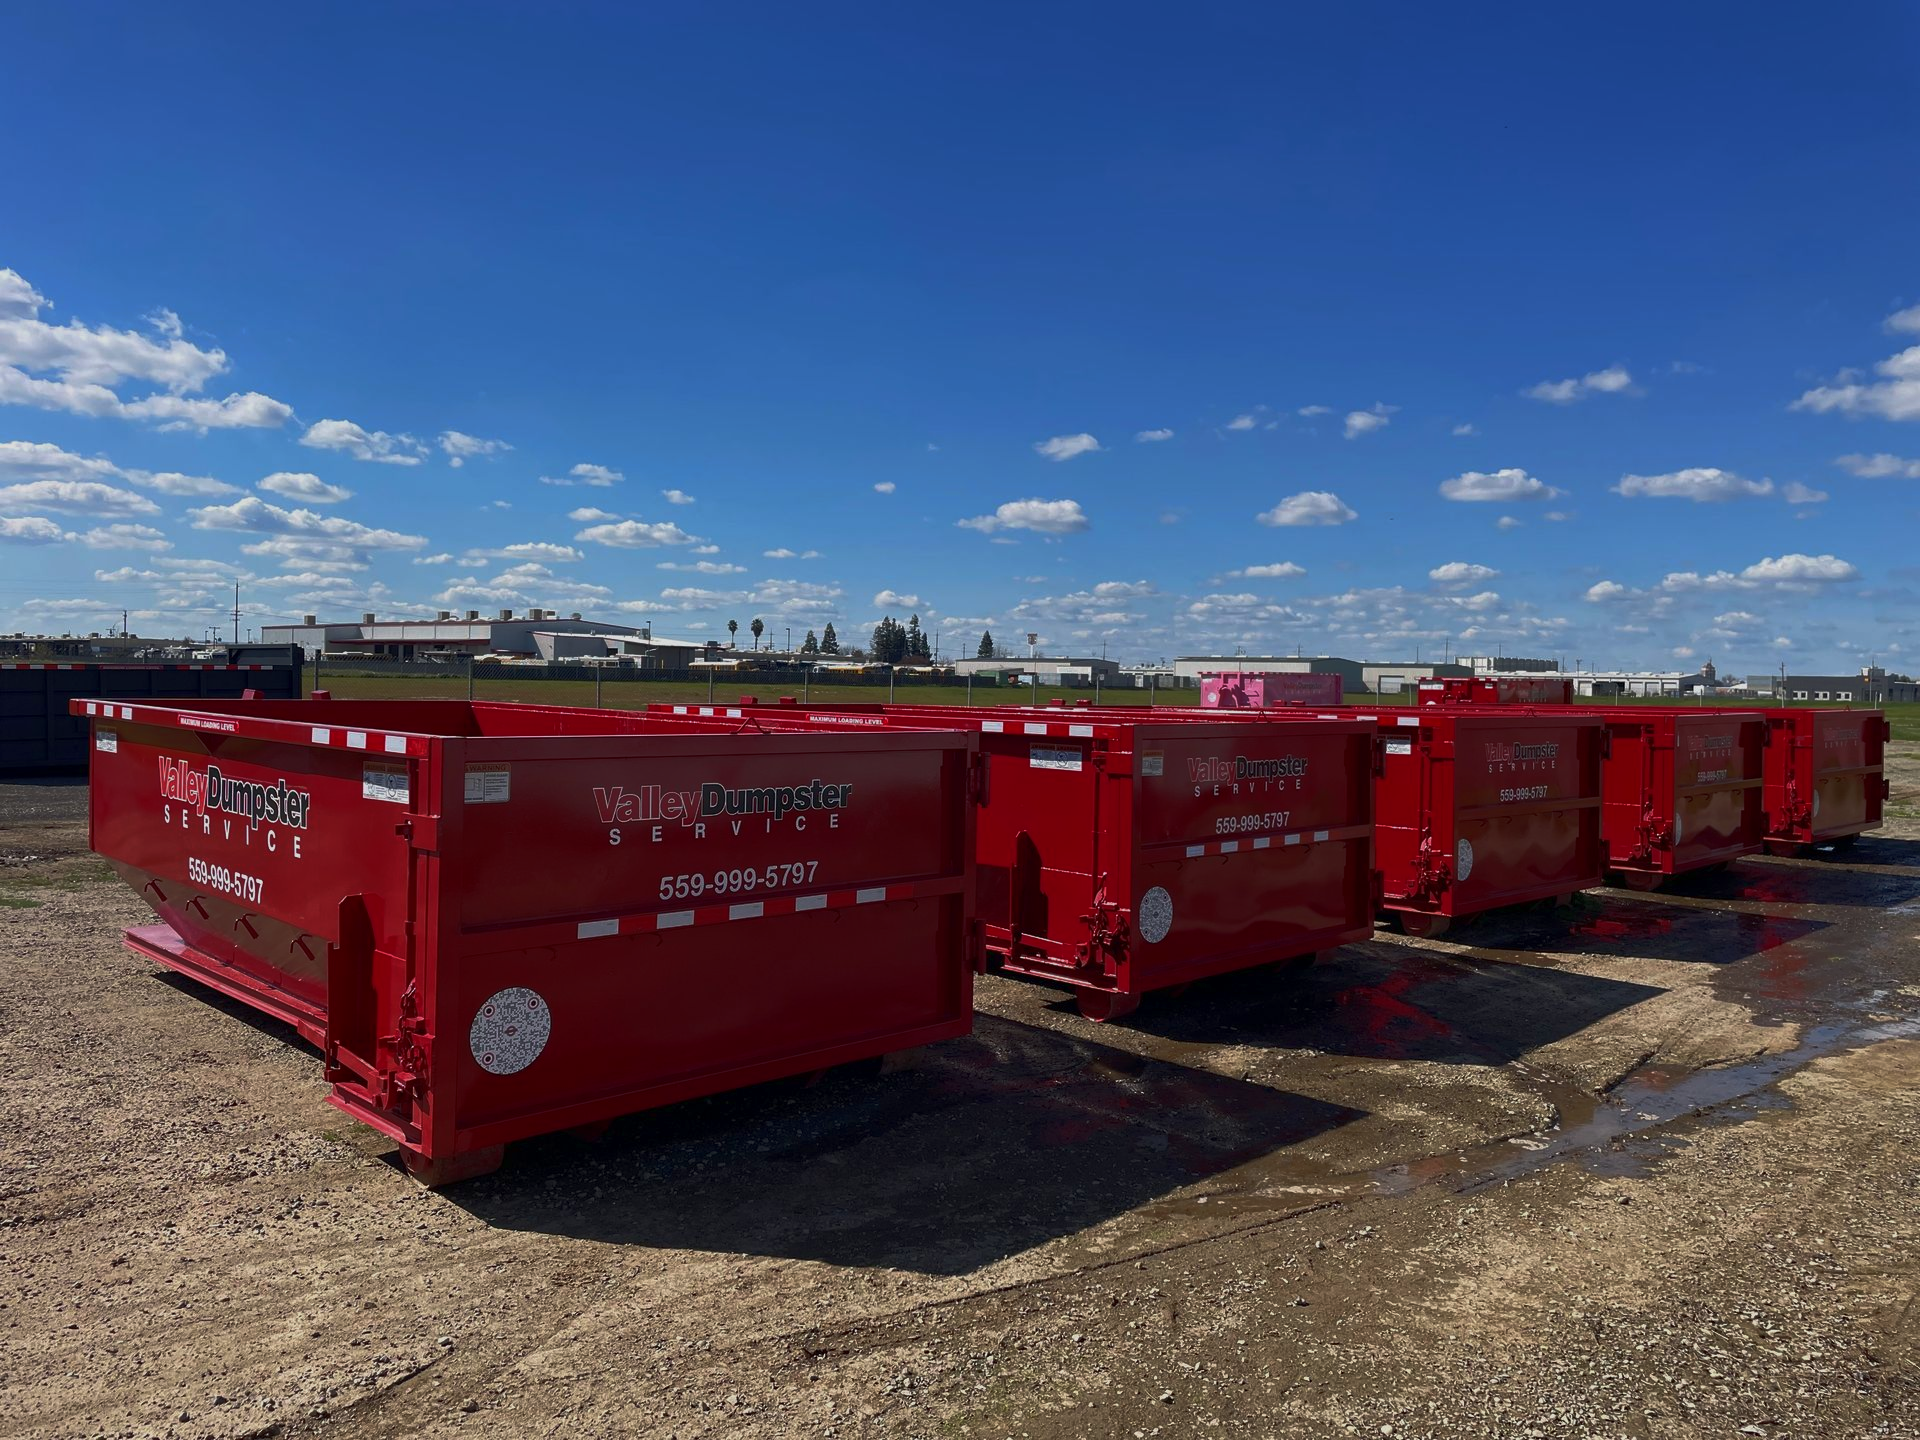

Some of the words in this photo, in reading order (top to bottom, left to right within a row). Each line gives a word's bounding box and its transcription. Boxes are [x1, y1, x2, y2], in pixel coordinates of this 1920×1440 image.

[469, 764, 506, 772] WARNING
[1499, 785, 1549, 802] 559-999-5797
[1215, 811, 1290, 834] 559-999-5797
[188, 856, 264, 904] 559-999-5797
[658, 860, 820, 901] 559-999-5797
